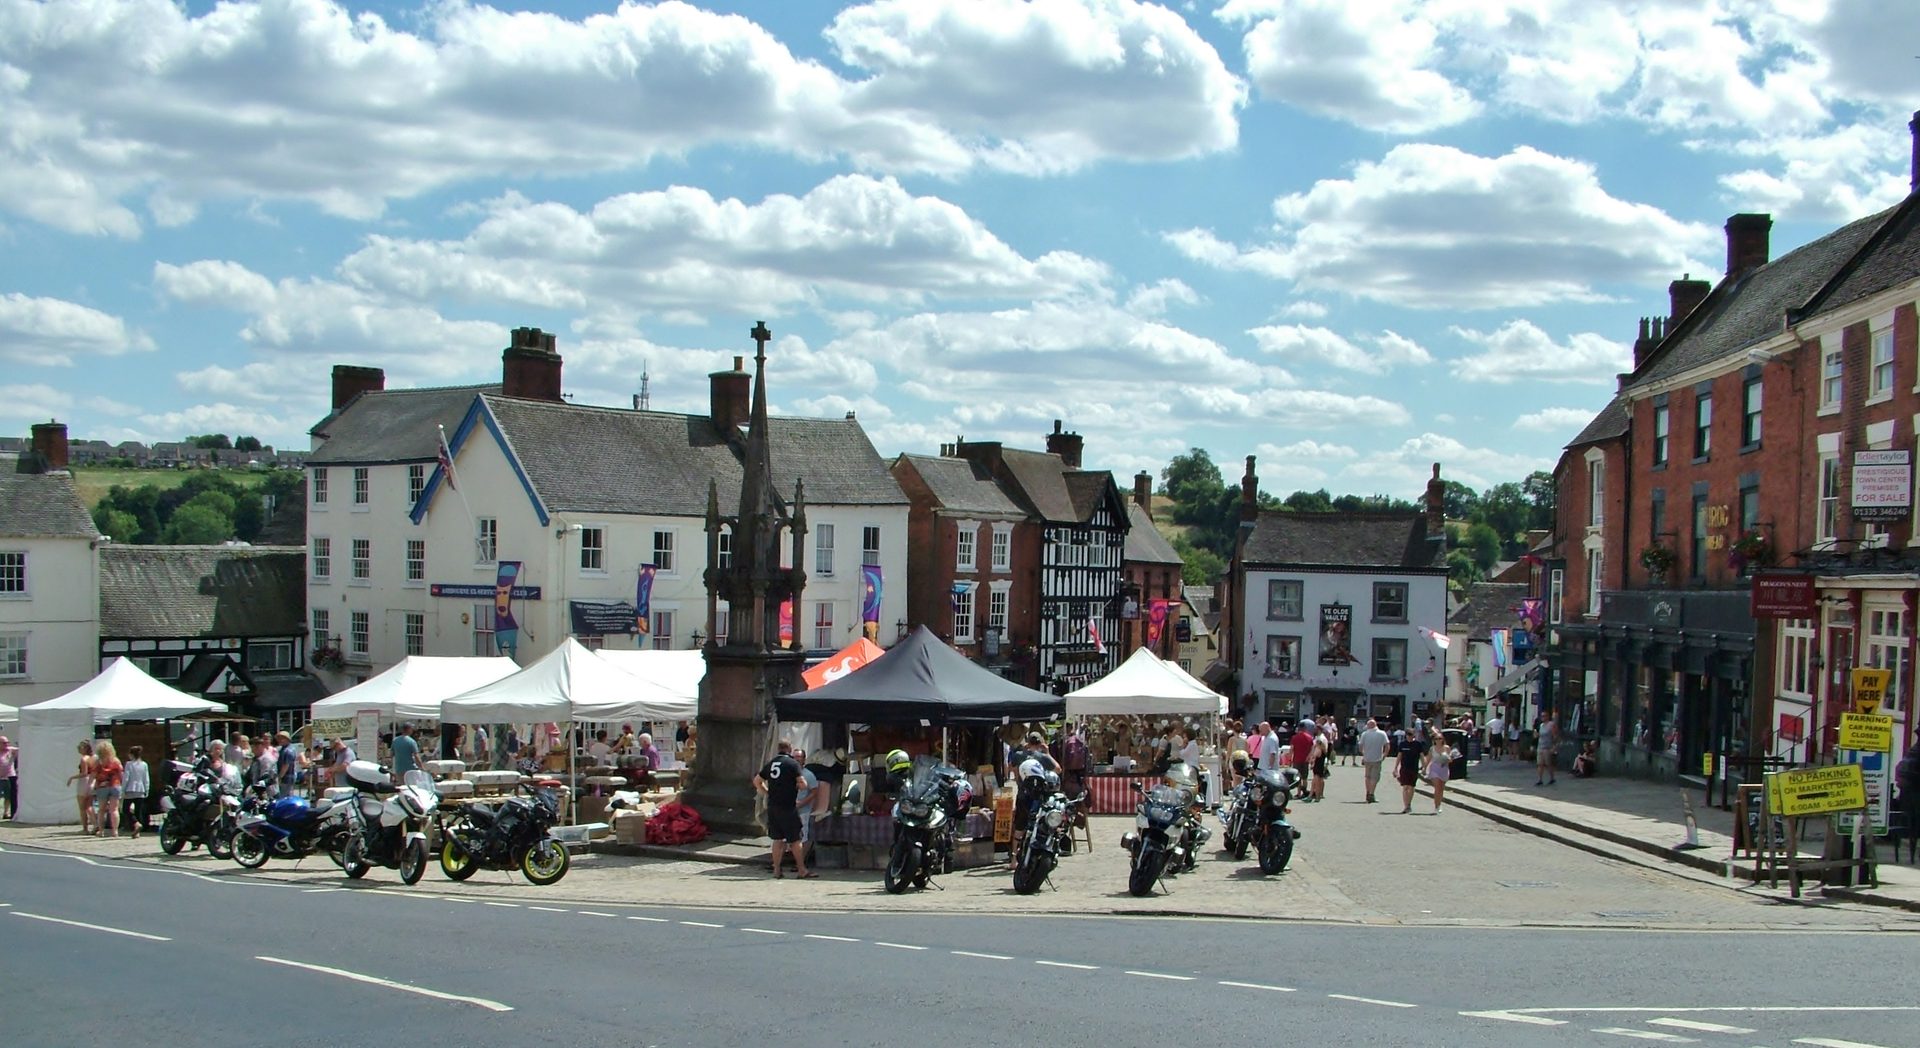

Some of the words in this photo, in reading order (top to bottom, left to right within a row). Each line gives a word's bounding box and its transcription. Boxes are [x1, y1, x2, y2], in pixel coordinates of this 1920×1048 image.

[1856, 494, 1876, 502] FOR
[1862, 676, 1879, 687] PAY
[1858, 690, 1880, 701] HERE
[1846, 715, 1888, 724] WARNING
[770, 761, 782, 779] 5
[1788, 775, 1804, 783] NO
[1806, 768, 1852, 781] PARKING
[1784, 787, 1797, 795] ON
[1798, 783, 1835, 793] MARKET
[1837, 781, 1859, 789] DAYS
